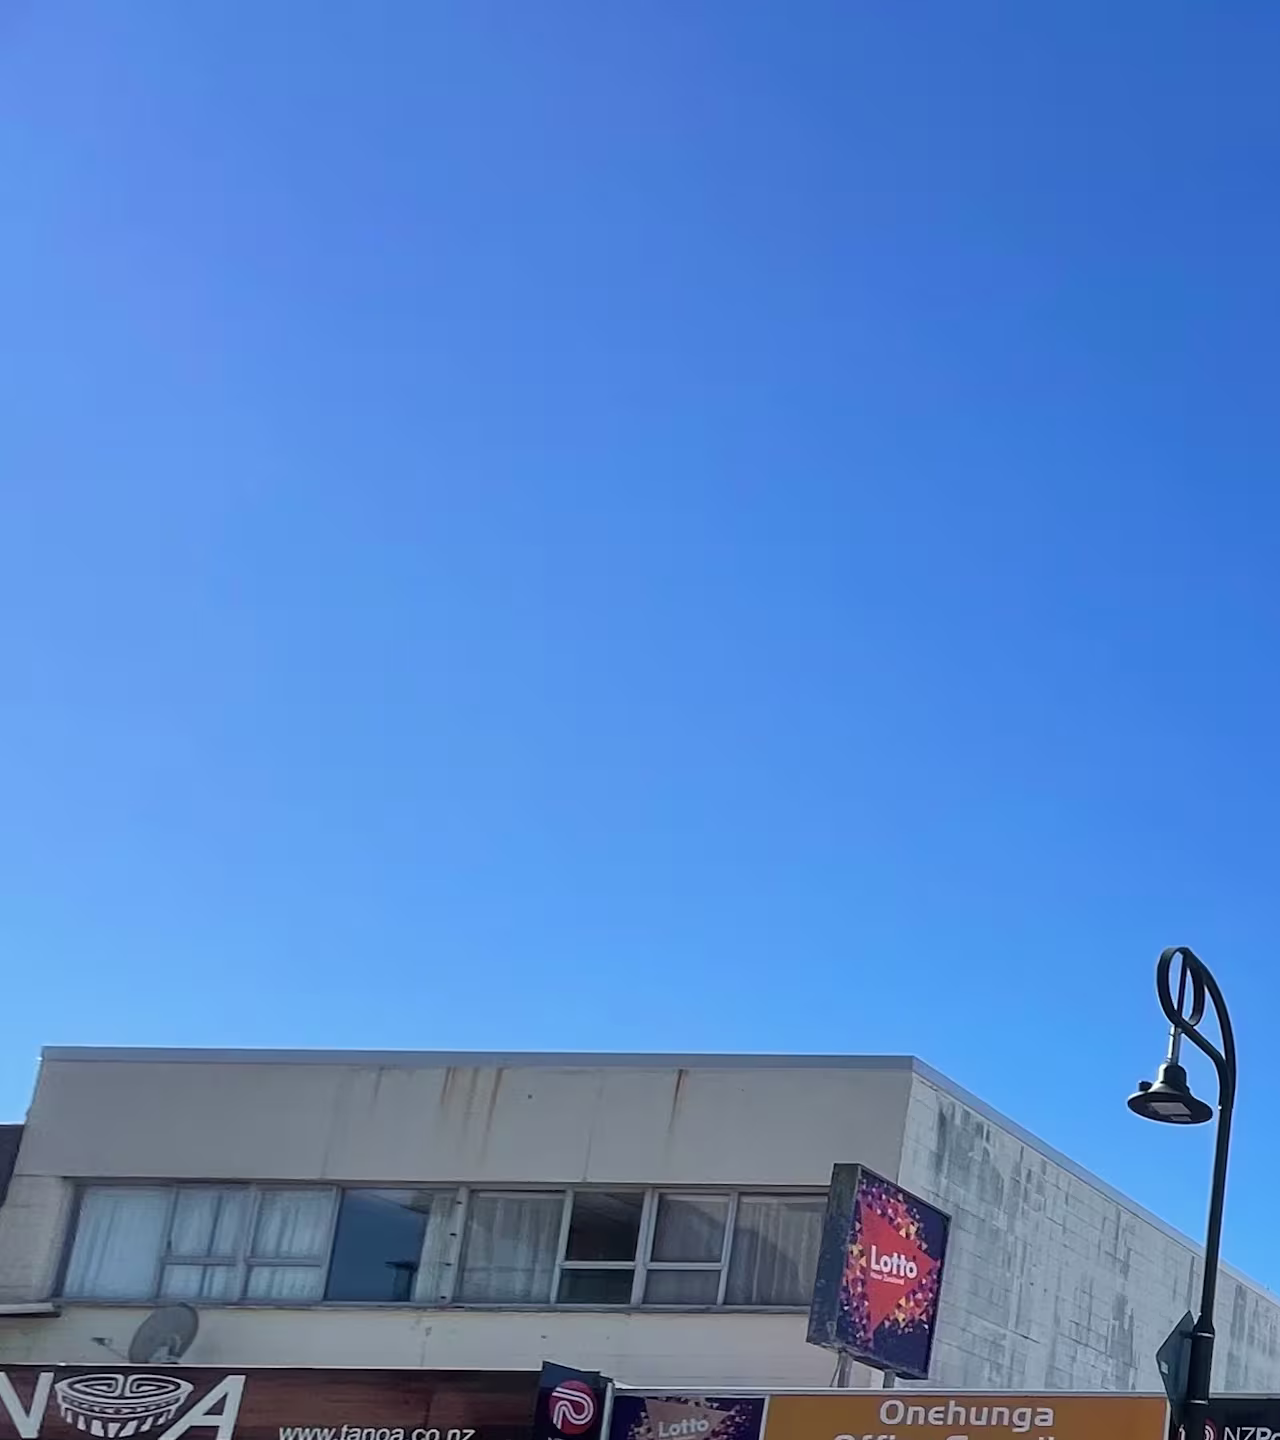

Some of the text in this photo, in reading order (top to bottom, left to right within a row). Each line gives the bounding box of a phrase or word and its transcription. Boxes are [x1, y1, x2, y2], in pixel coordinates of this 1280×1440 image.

[869, 1244, 918, 1279] Lotto
[657, 1417, 710, 1439] Lotto
[879, 1399, 1055, 1433] Onehunga
